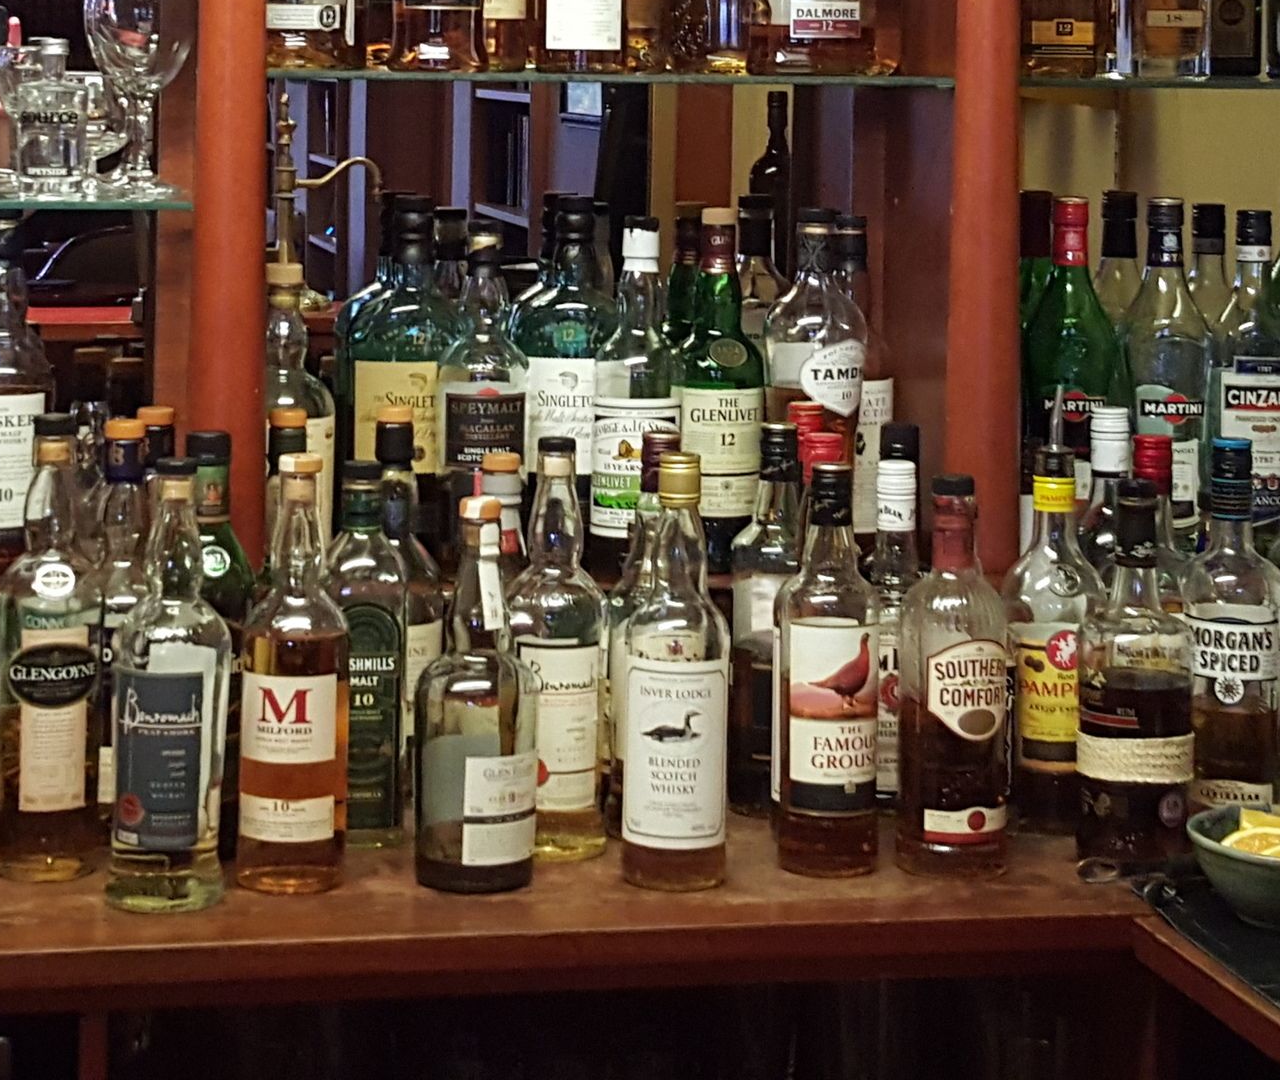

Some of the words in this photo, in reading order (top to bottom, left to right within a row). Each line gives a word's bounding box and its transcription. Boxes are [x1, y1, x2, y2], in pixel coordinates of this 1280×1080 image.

[321, 10, 334, 24] 12
[796, 8, 857, 18] DALMORE
[822, 21, 834, 31] 12
[1057, 23, 1072, 33] 12
[451, 400, 520, 416] SPEYMALT
[719, 397, 739, 409] THE
[1144, 402, 1203, 414] MARTINI
[690, 408, 759, 423] GLENLIVET
[720, 432, 736, 447] 12
[1188, 626, 1274, 650] MORGAN'S
[1200, 651, 1261, 673] SPICED
[9, 664, 97, 682] GLENGOYNE
[935, 658, 1005, 681] SOUTHER
[350, 676, 379, 686] MALT
[639, 685, 672, 699] INVER
[675, 686, 711, 698] LODGE
[258, 686, 314, 724] M
[354, 693, 374, 707] 10
[257, 726, 313, 736] MILFORD
[838, 726, 862, 735] THE
[648, 756, 701, 769] BLENDED
[650, 770, 697, 782] SCOTCH
[650, 783, 696, 795] WHISKY
[273, 800, 291, 812] 10
